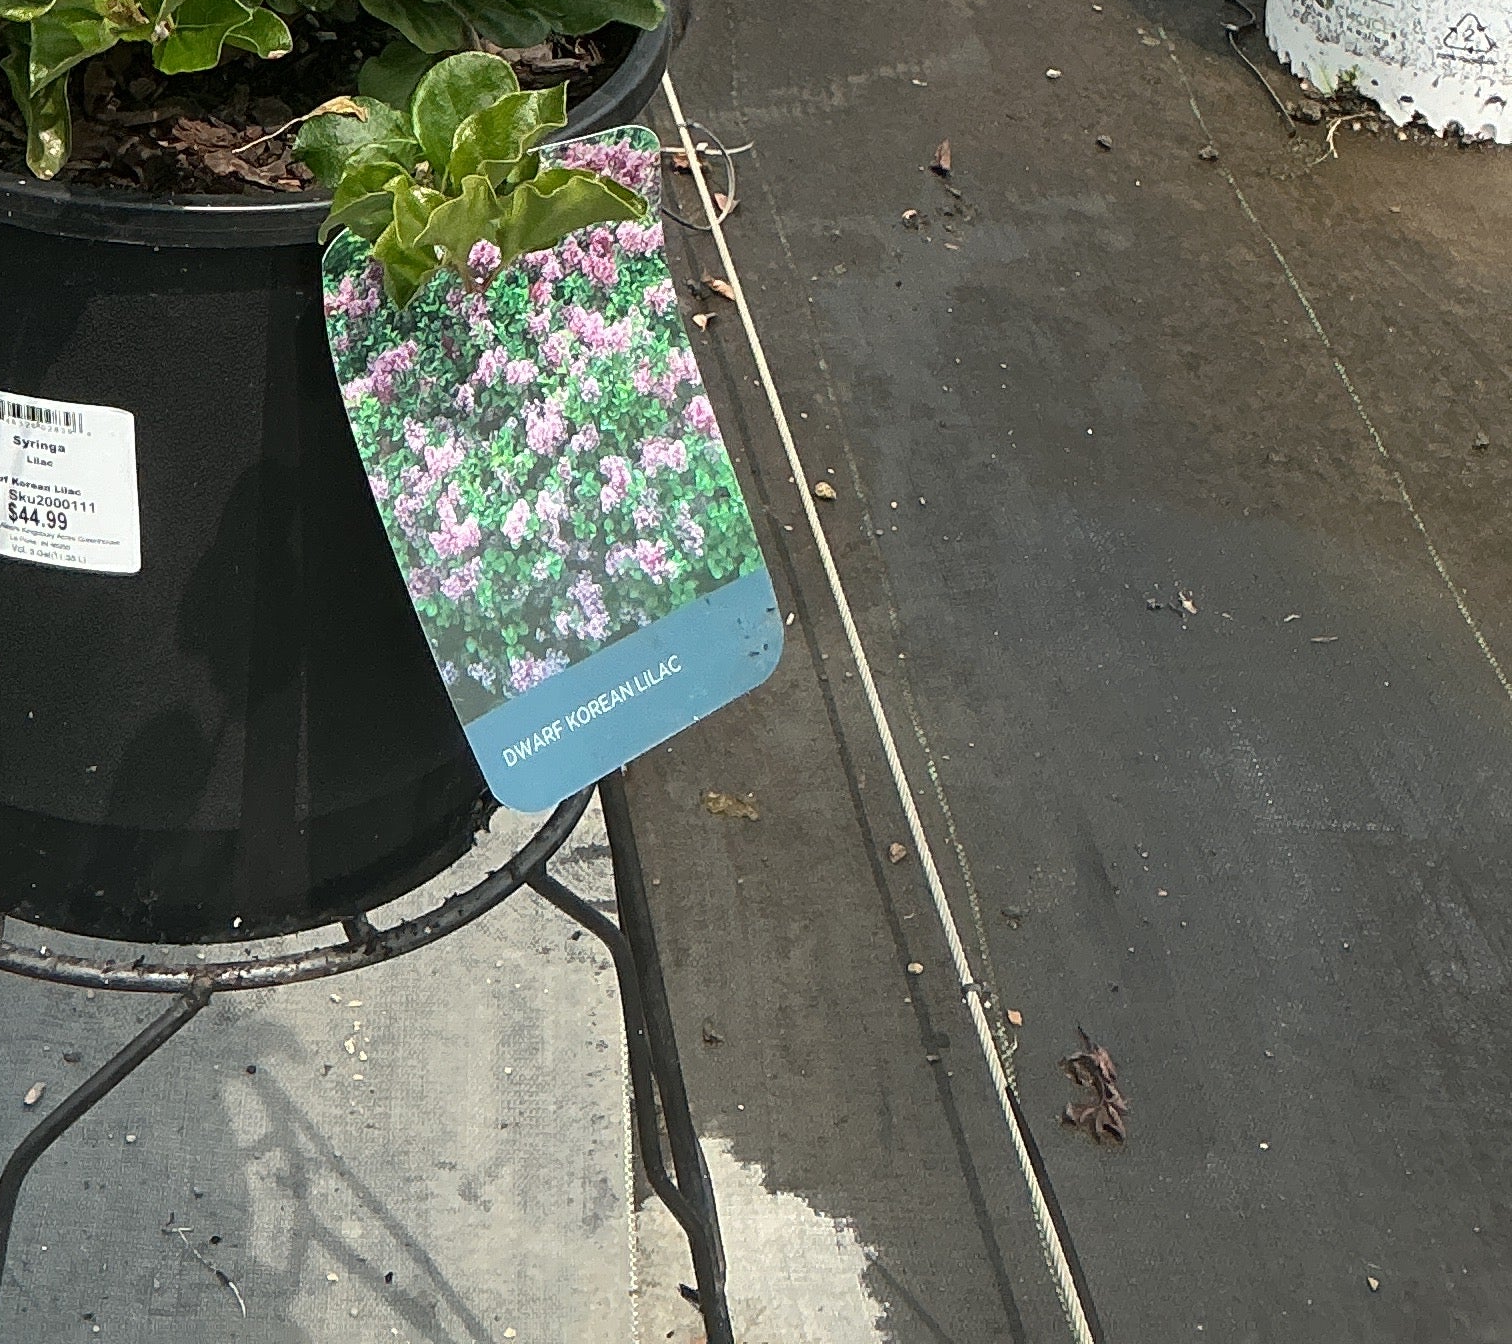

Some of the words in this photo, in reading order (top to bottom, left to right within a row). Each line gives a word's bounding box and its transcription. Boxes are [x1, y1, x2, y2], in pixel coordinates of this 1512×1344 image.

[13, 435, 65, 454] Syringa
[27, 456, 53, 467] Lilac
[12, 477, 51, 492] Korean
[54, 485, 81, 497] Lilac
[9, 489, 95, 513] Sku2000111
[8, 501, 67, 530] $44.99
[502, 721, 563, 767] DWARF
[565, 681, 635, 732] KOREAN
[633, 654, 683, 693] LILAC
